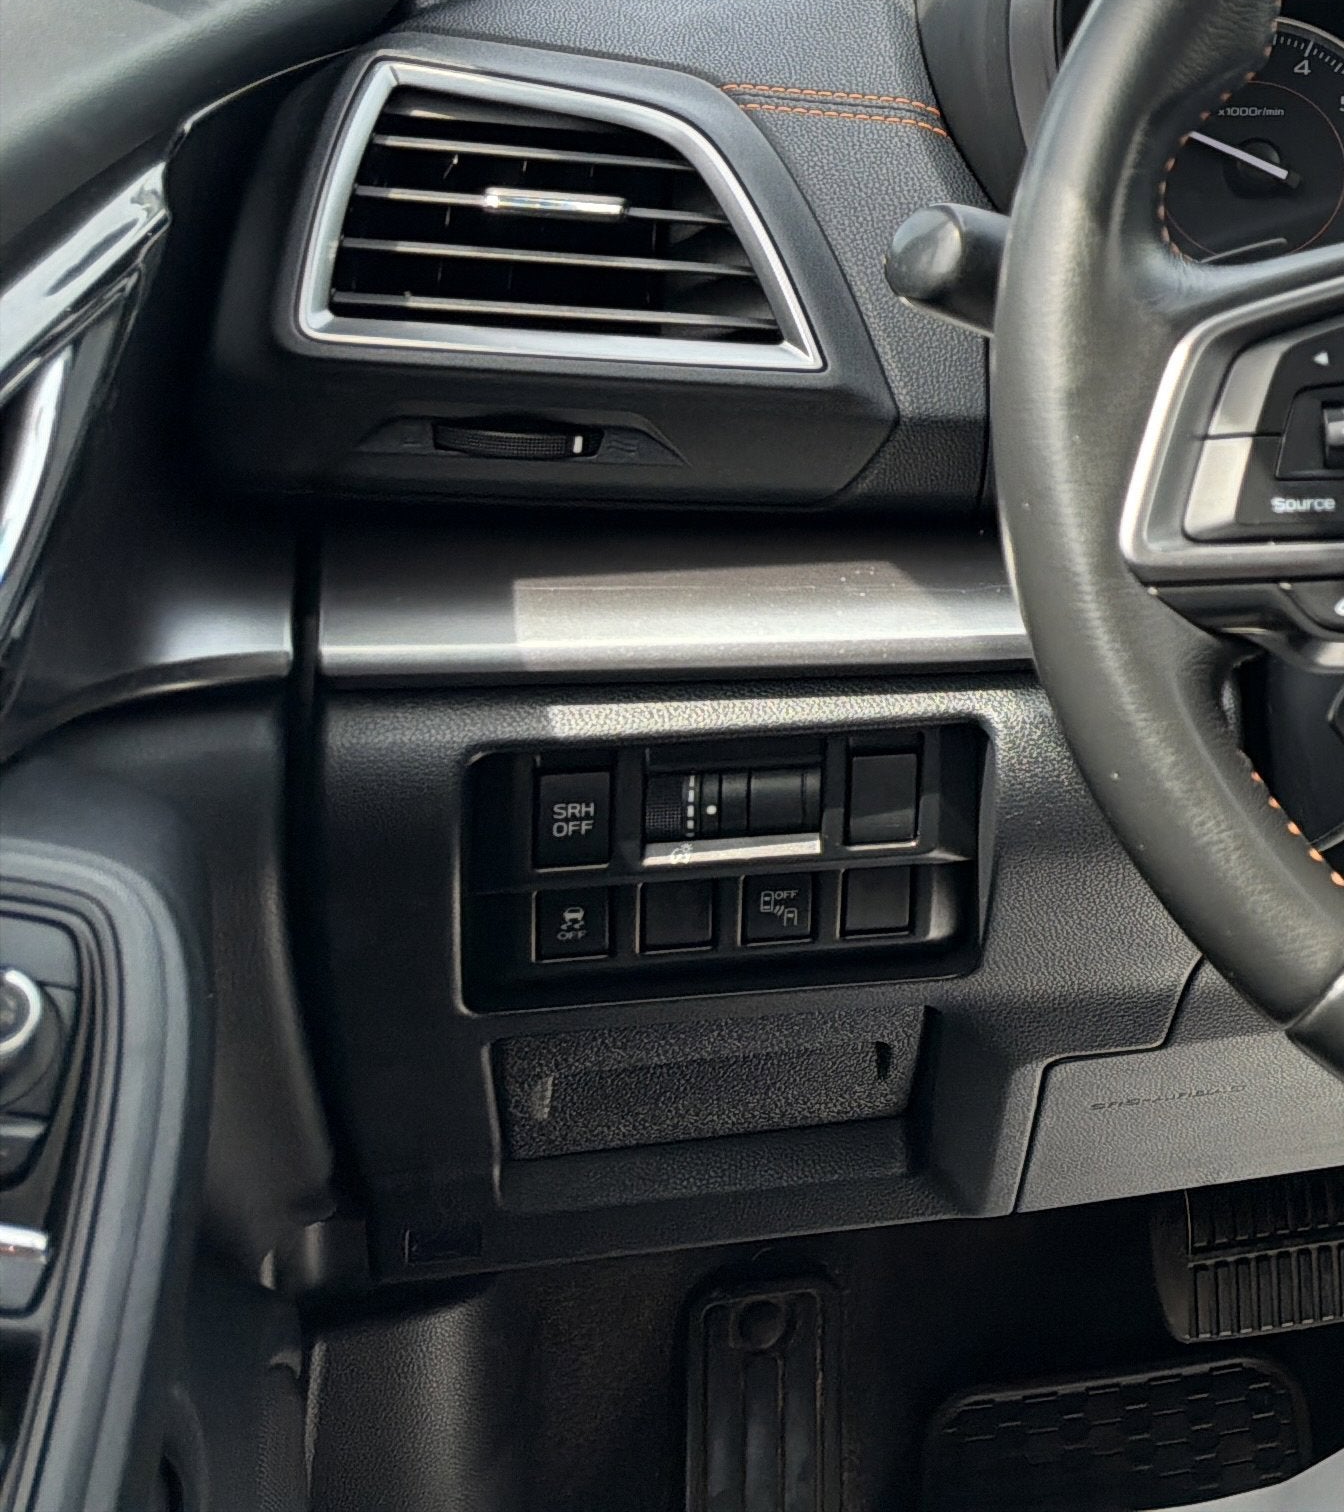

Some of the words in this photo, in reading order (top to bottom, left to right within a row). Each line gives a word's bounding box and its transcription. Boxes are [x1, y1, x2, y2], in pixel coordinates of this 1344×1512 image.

[1293, 58, 1311, 76] 4
[1271, 496, 1336, 514] Source
[552, 802, 595, 820] SRH
[552, 819, 594, 837] OFF
[773, 890, 798, 900] OFF
[557, 930, 586, 941] OFF
